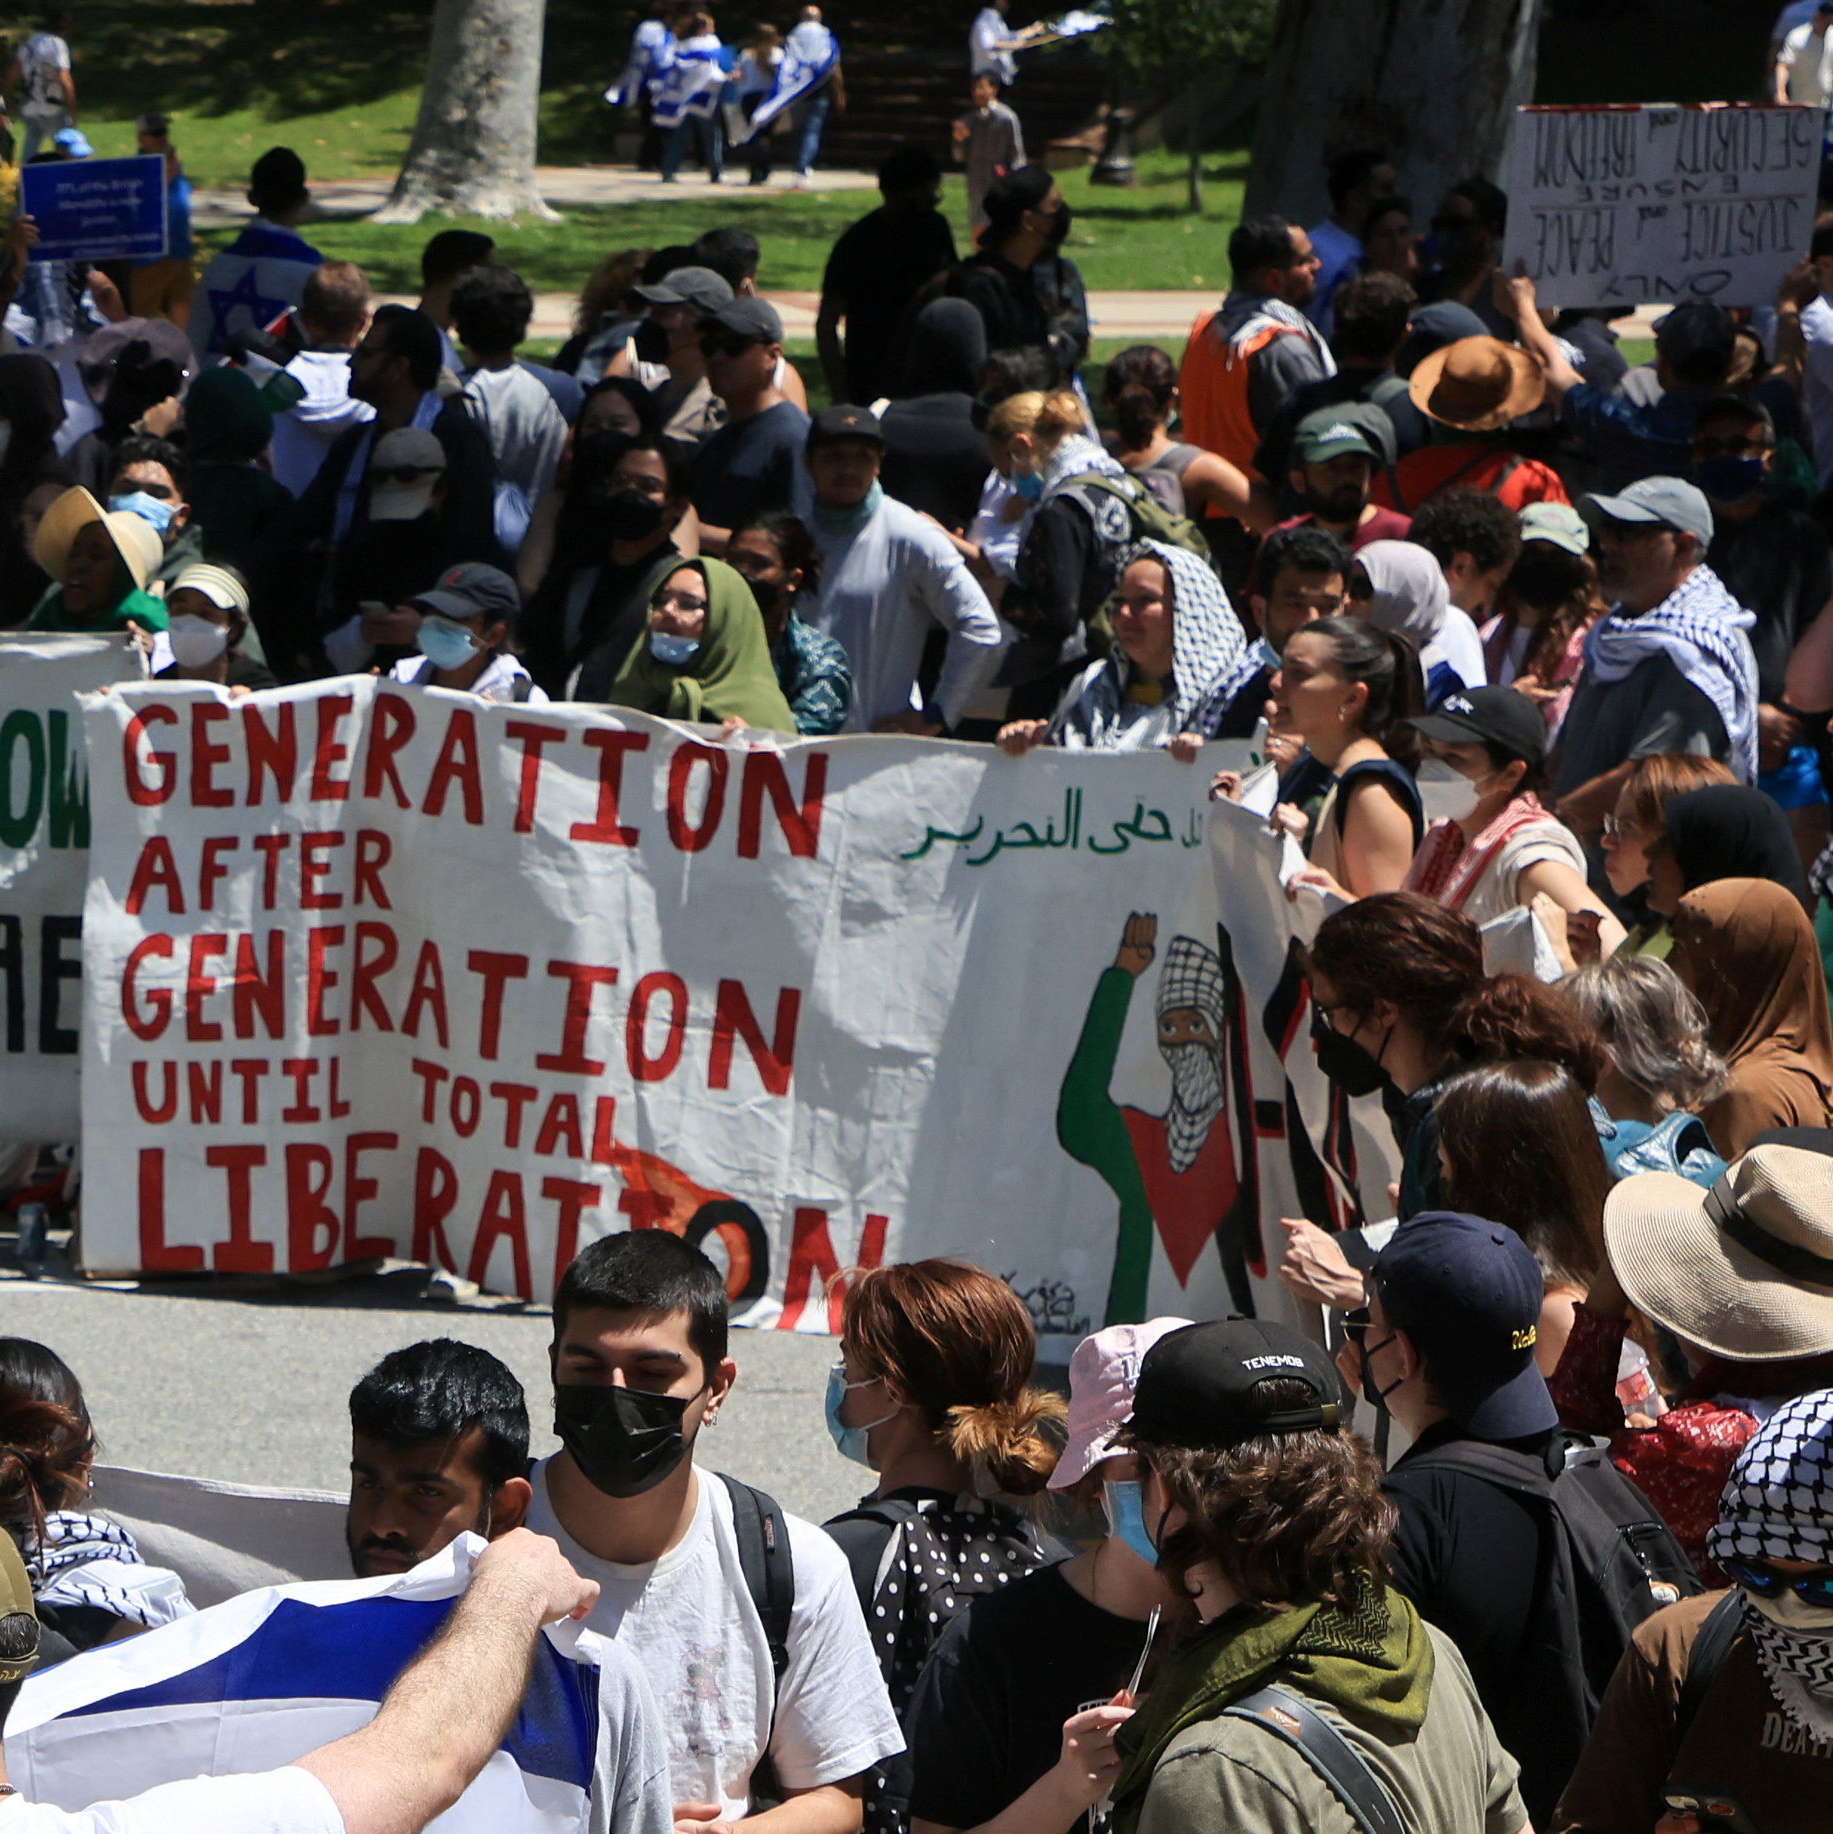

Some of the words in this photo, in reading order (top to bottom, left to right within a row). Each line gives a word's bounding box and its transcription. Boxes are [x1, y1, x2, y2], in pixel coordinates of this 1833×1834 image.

[1674, 110, 1815, 175] SECURITY
[1577, 175, 1740, 202] ENSURE
[1534, 209, 1616, 281] PEACE
[1681, 200, 1800, 262] JUSTICE
[1598, 270, 1732, 300] ONLY
[122, 693, 830, 860] GENERATION
[125, 829, 394, 916] AFTER
[121, 921, 801, 1096] GENERATION
[132, 1056, 351, 1124] UNTIL
[411, 1059, 619, 1166] TOTAL
[1241, 1354, 1305, 1371] TENEMOS
